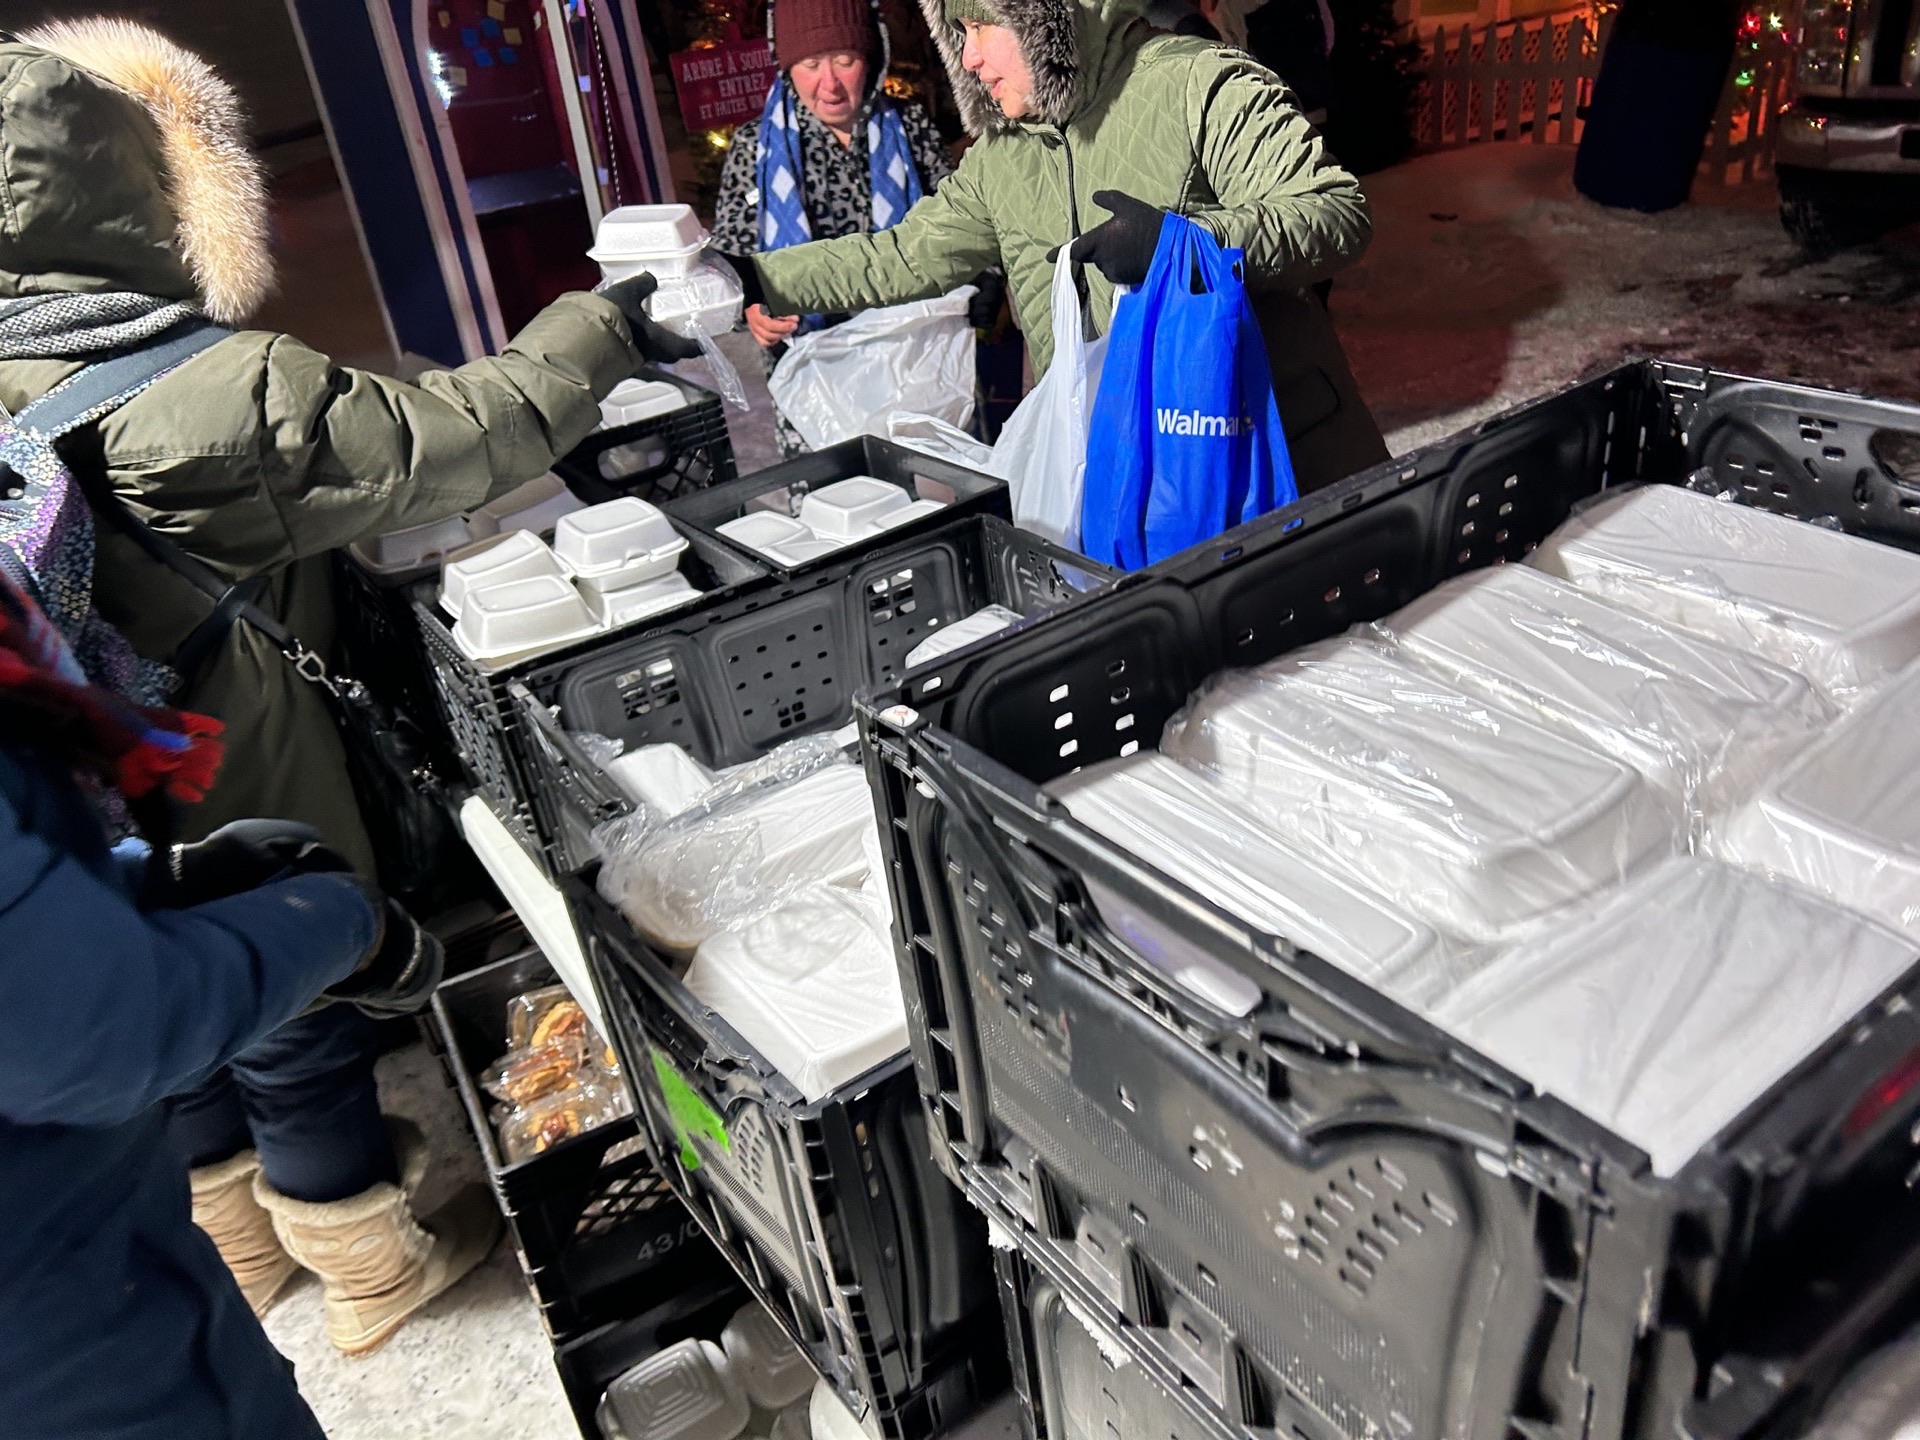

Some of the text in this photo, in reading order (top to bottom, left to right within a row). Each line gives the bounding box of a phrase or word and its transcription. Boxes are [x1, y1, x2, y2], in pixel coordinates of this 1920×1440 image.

[682, 48, 774, 82] ARBRE À SOUH
[718, 73, 769, 98] ENTREZ
[699, 104, 713, 119] ET
[714, 97, 748, 116] FAITES
